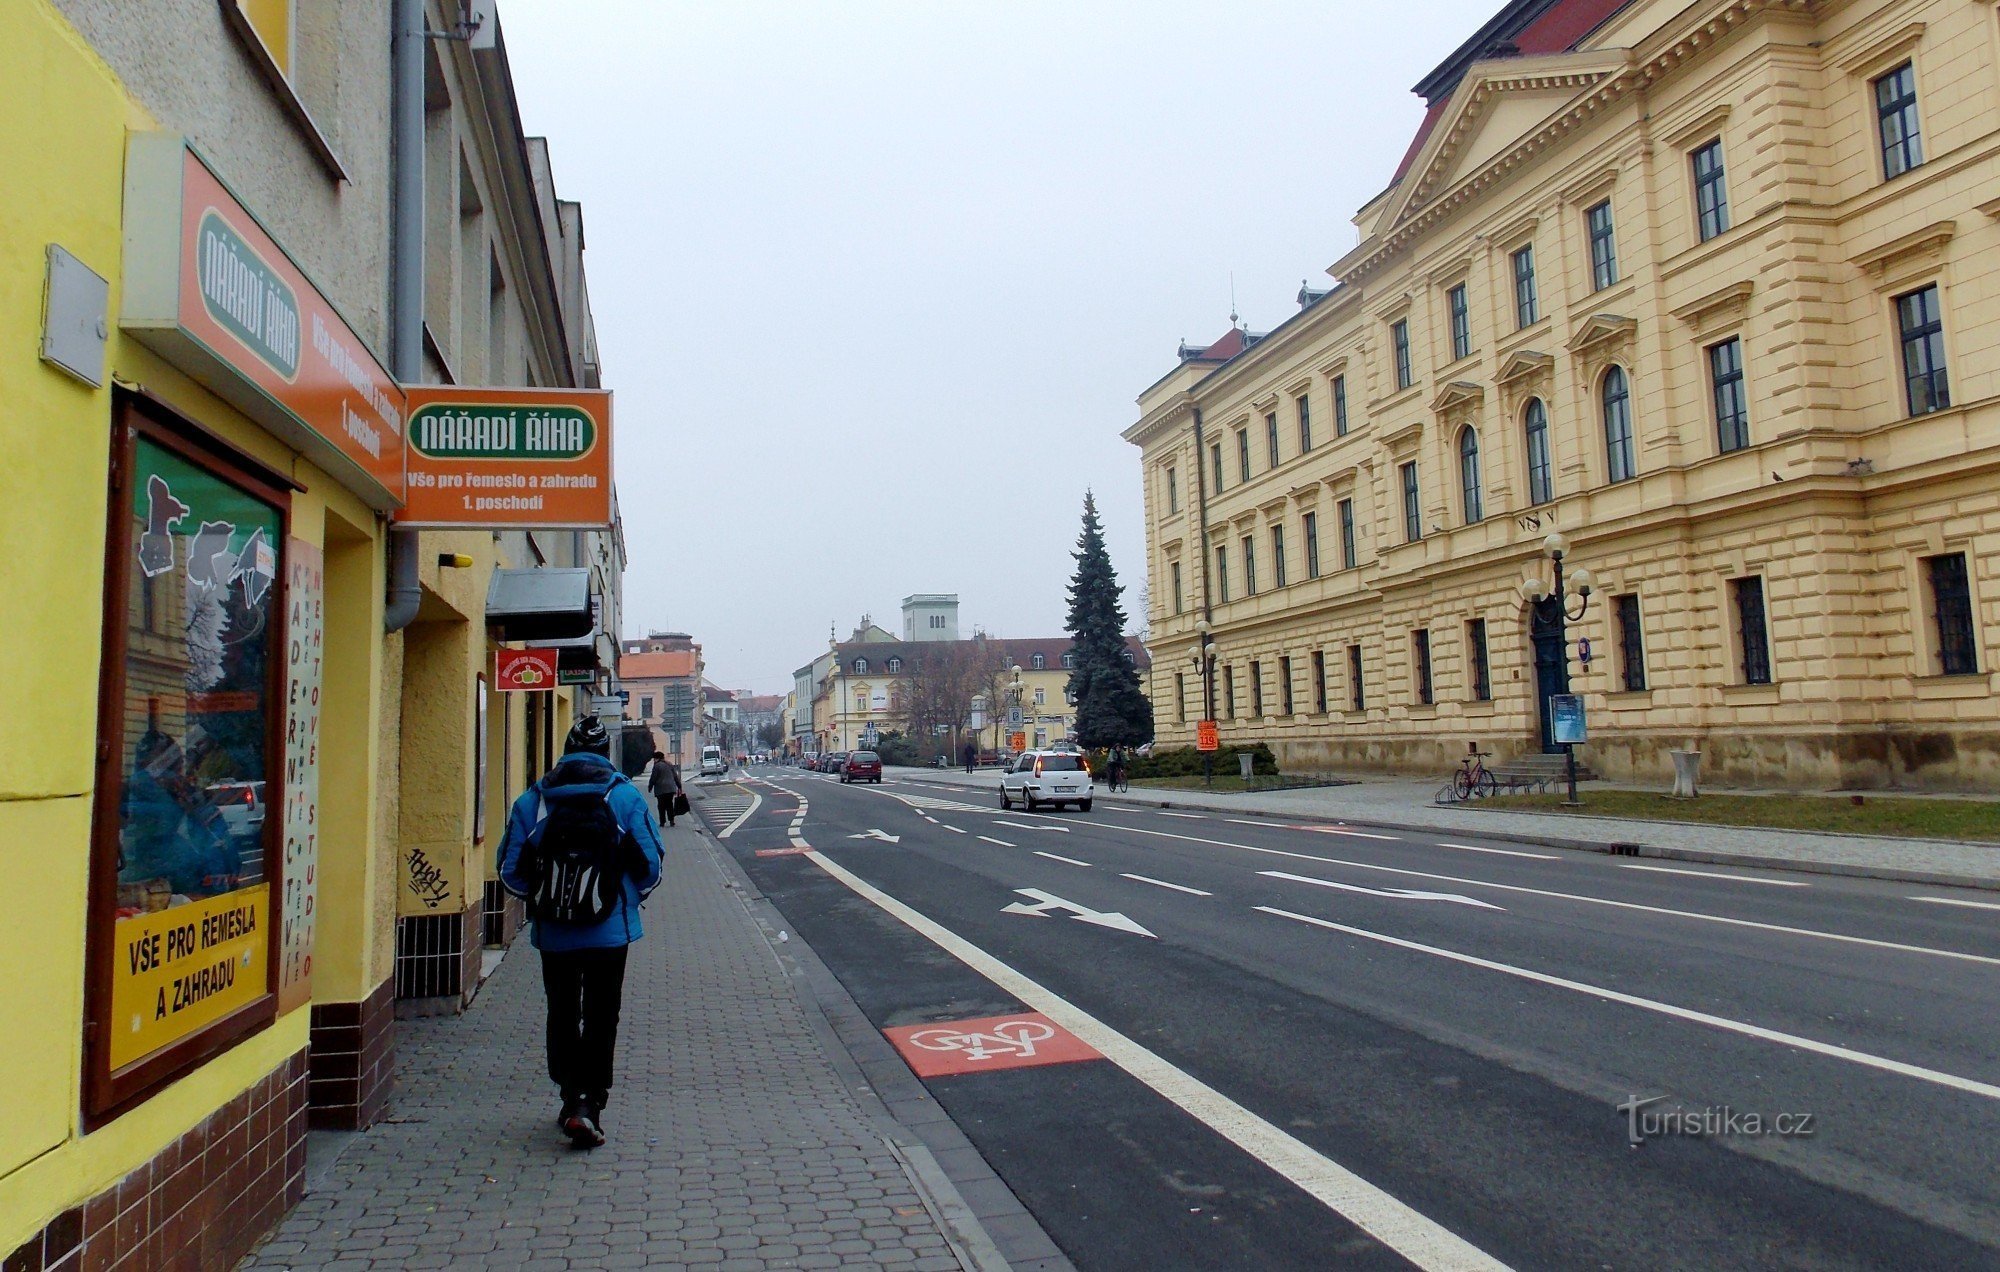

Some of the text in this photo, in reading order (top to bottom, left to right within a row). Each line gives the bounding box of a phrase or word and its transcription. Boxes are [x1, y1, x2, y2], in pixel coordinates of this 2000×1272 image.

[204, 230, 297, 370] NÁŘADÍ ŘÍHA
[420, 410, 584, 451] NÁŘADÍ ŘÍHA
[408, 471, 597, 489] Vše pro řemeslo a zahradu
[462, 495, 544, 512] 1. poschodí
[284, 563, 302, 989] KADEŘNICTVÍ
[303, 570, 321, 977] NEHTOVÉ STUDIO
[129, 904, 257, 976] VŠE PRO ŘEMESLA
[155, 957, 236, 1021] A ZAHRADU
